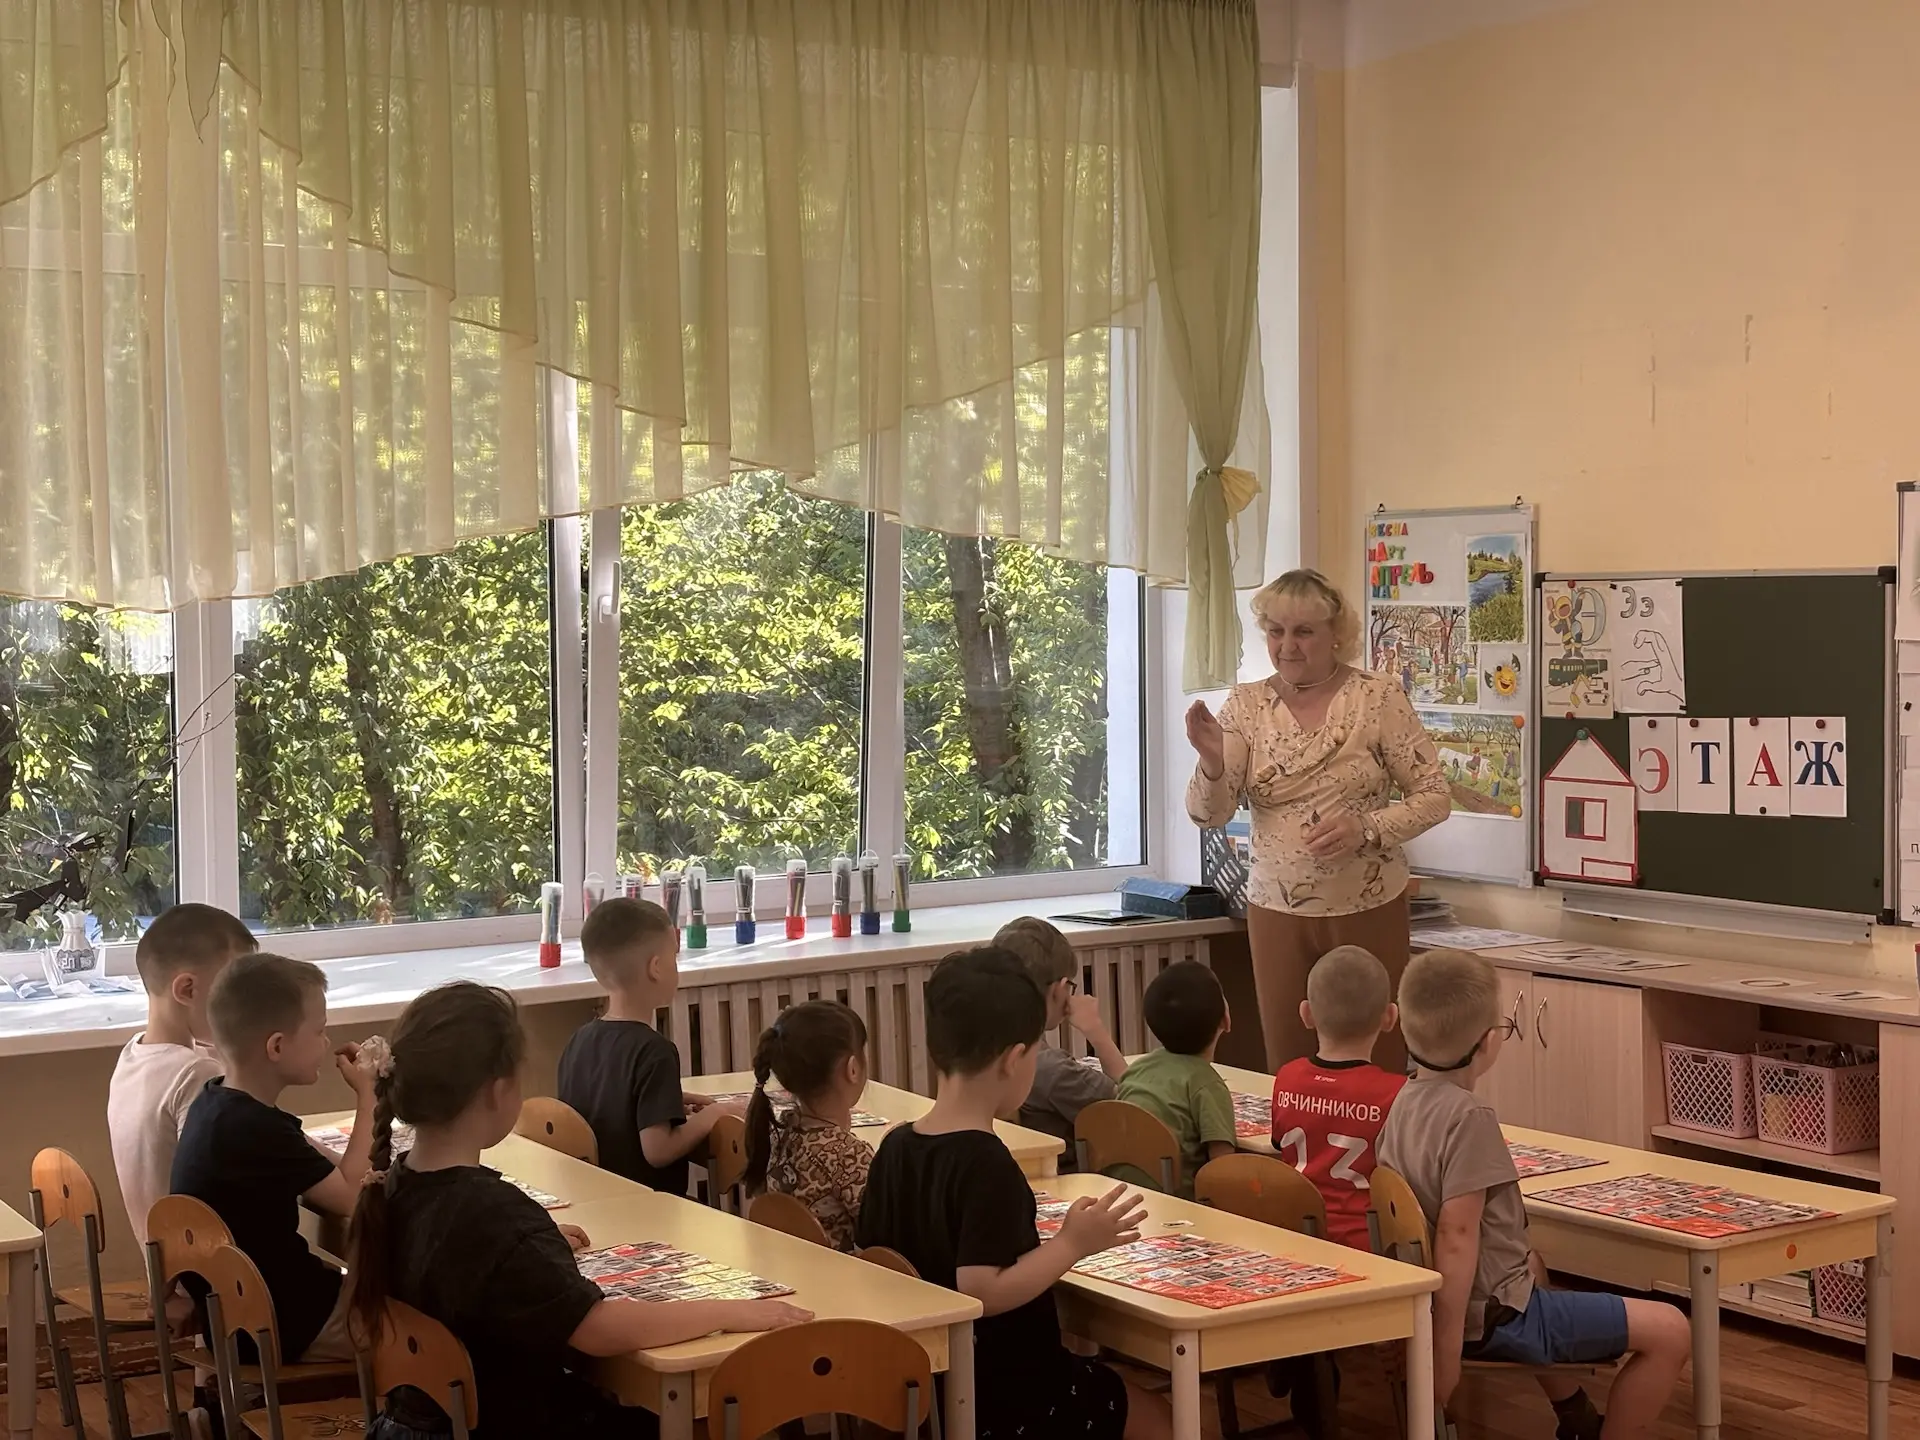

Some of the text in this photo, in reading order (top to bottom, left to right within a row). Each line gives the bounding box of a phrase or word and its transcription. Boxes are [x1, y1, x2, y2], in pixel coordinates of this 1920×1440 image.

[1369, 523, 1408, 537] ВЕСНА
[1368, 542, 1406, 562] МАРТ
[1371, 561, 1434, 586] АПРЕЛЬ
[1278, 1091, 1380, 1122] ОВЧИННИКОВ
